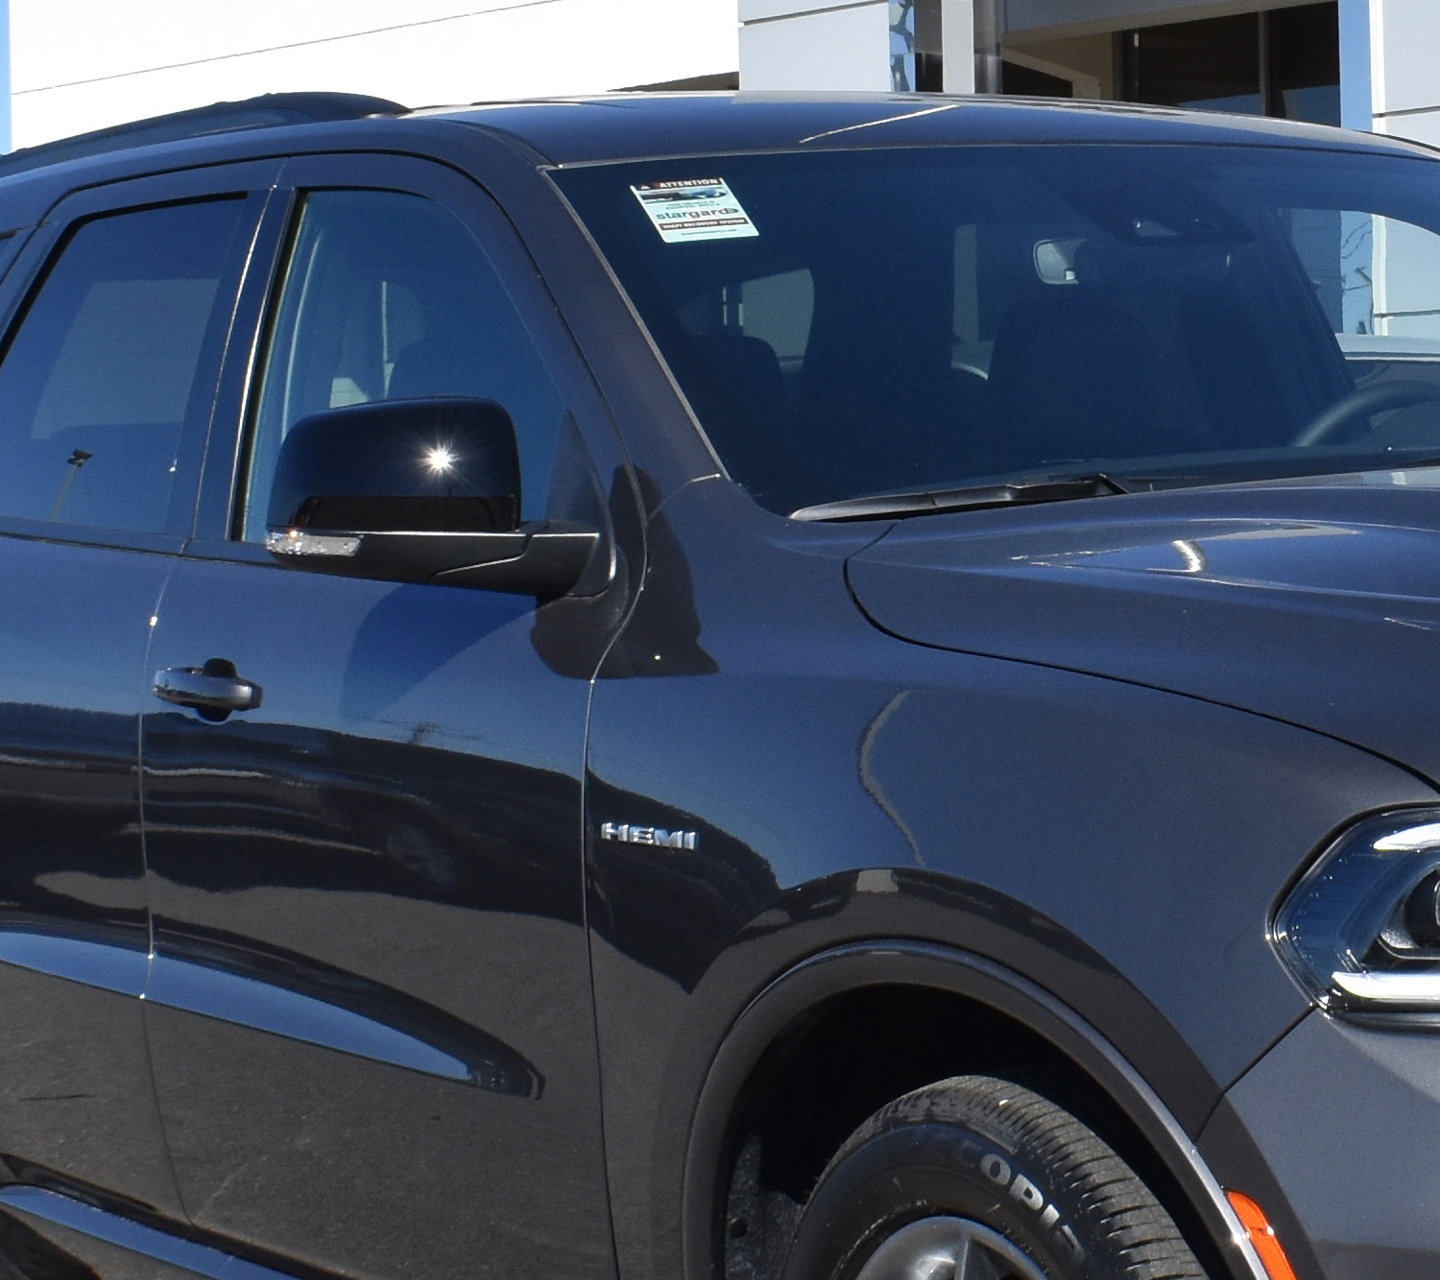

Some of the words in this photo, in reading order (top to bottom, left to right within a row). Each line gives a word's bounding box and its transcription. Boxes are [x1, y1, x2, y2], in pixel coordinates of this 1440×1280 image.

[659, 178, 719, 189] ATTENTION
[655, 207, 731, 219] stargard
[600, 822, 699, 851] HEMI
